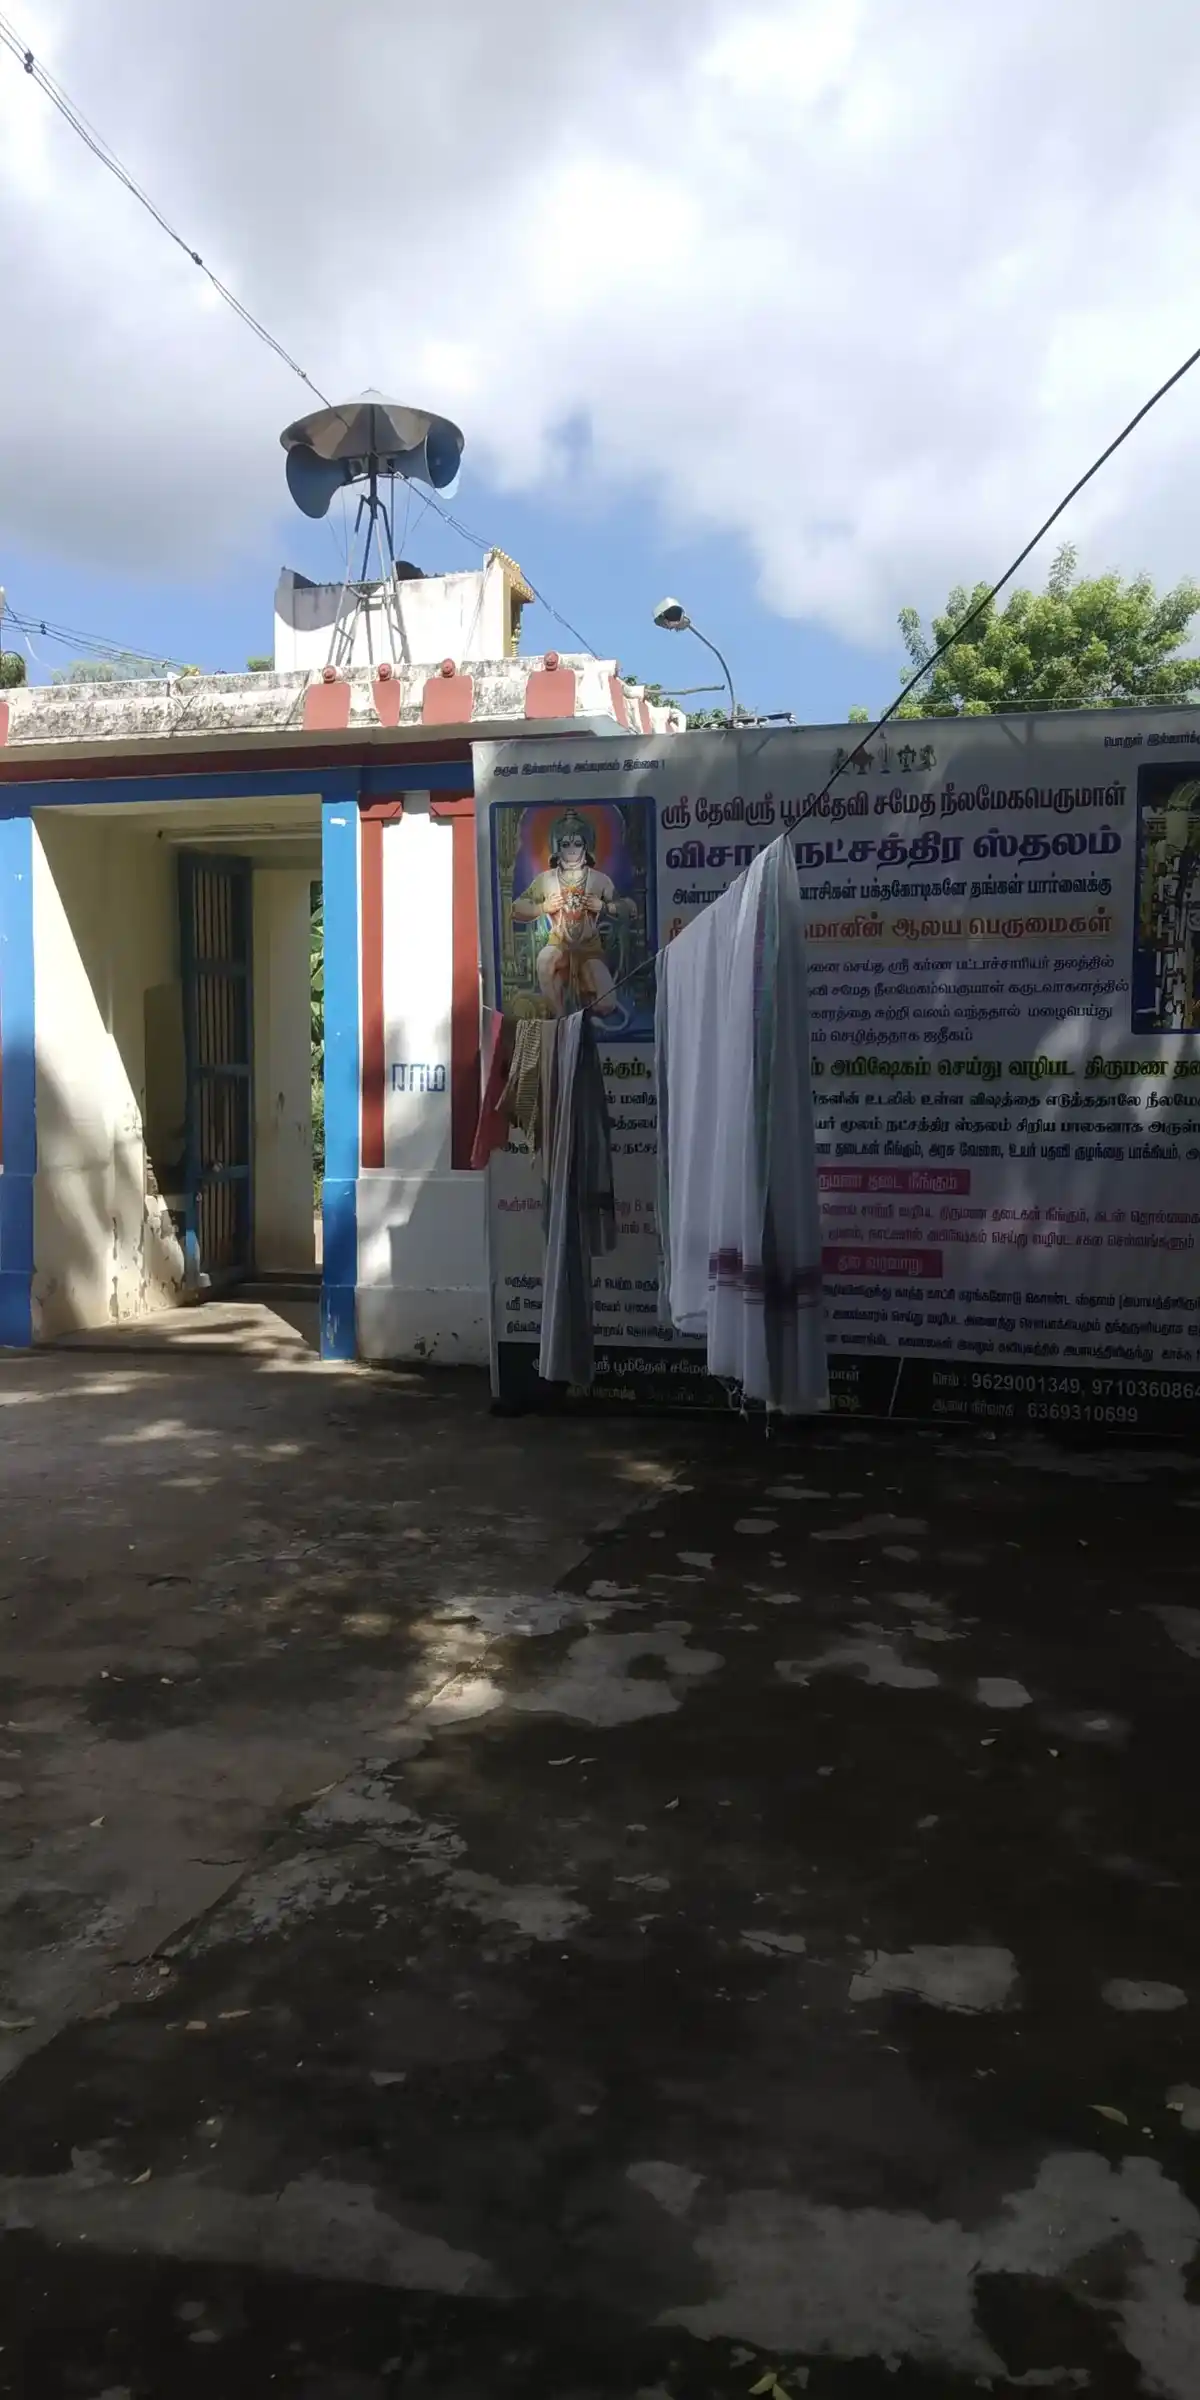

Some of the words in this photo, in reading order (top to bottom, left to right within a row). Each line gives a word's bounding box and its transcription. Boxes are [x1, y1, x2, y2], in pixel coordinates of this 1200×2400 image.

[661, 794, 691, 829] ஸ்ரீ
[695, 790, 776, 829] தேவிஸ்ரீ
[873, 786, 936, 821] சமேத
[940, 779, 1128, 821] நீலமேகபெருமாள்
[666, 839, 765, 871] விசா
[972, 829, 1122, 873] ஸ்தலம்
[860, 875, 967, 905] பக்தகோடிகளே
[970, 872, 1024, 898] தங்கள்
[1028, 871, 1112, 897] பார்வைக்கு
[891, 916, 963, 943] ஆலய
[967, 905, 1113, 941] பெருமைகள்
[842, 956, 886, 974] செய்த
[1052, 953, 1115, 973] தலத்தில்
[830, 982, 870, 999] சமேத
[874, 1004, 911, 1023] சுற்றி
[912, 1004, 950, 1020] வலம்
[953, 1003, 1020, 1021] வந்ததால்
[1026, 1003, 1113, 1022] மழைபெய்து
[830, 1055, 932, 1084] அபிஷேகம்
[937, 1053, 1002, 1082] செய்து
[1008, 1055, 1077, 1082] வழிபட
[1083, 1055, 1169, 1081] திருமண
[865, 1089, 917, 1106] உடலில்
[920, 1089, 964, 1106] உள்ள
[953, 1115, 1012, 1134] ஸ்தலம்
[1015, 1117, 1057, 1135] சிறிய
[971, 1373, 1086, 1397] 9629001349,
[1027, 1402, 1138, 1422] 6369310699
